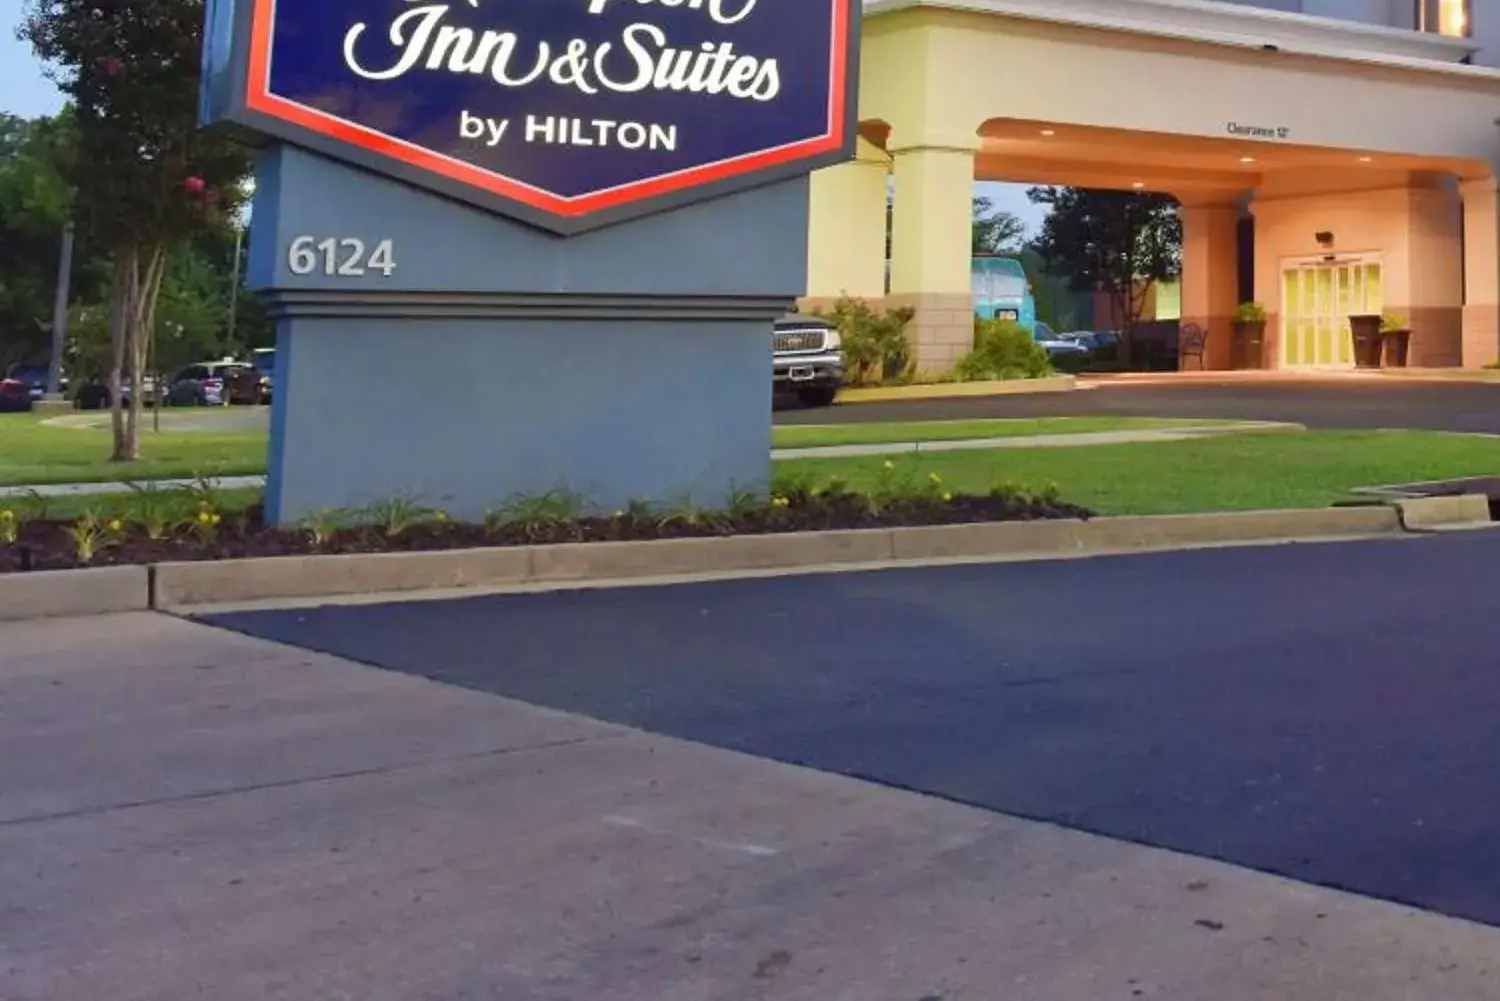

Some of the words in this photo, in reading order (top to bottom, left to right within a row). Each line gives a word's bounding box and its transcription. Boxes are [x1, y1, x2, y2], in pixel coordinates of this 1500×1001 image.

[344, 5, 550, 87] Inn
[549, 39, 598, 95] &
[594, 22, 780, 101] Suites
[459, 110, 509, 147] by
[525, 114, 677, 151] HILTON
[289, 235, 397, 276] 6124
